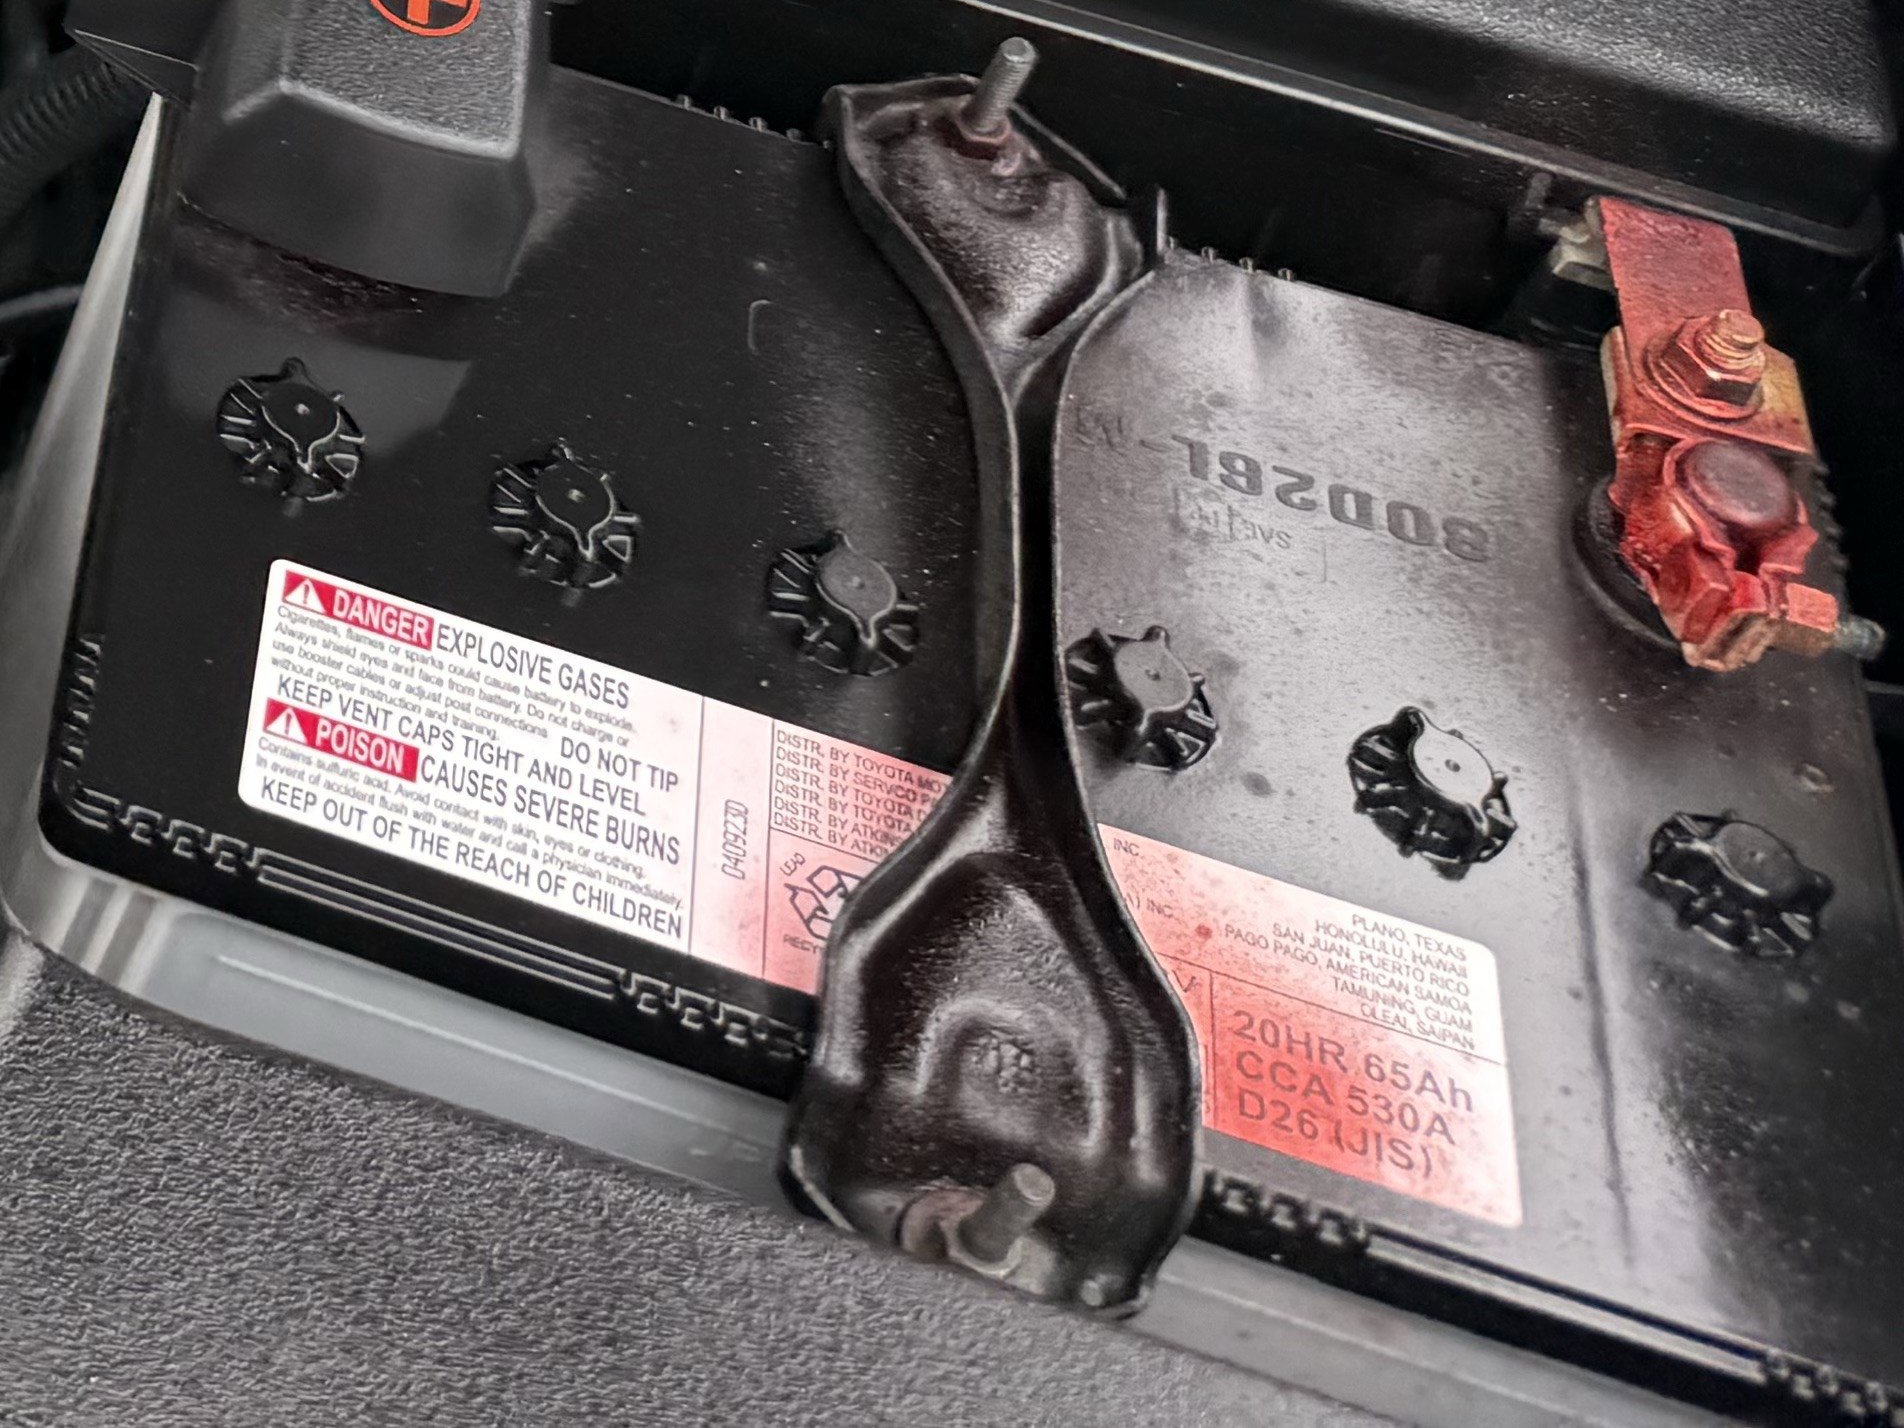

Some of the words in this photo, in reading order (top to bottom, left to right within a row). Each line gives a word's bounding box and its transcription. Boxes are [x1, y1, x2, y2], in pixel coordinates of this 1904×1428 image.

[270, 654, 314, 680] without
[315, 670, 355, 695] proper
[359, 683, 421, 715] instruction
[424, 704, 448, 724] and
[271, 640, 294, 656] use
[297, 646, 343, 672] booster
[345, 662, 386, 686] cables
[388, 678, 401, 691] or
[404, 682, 441, 706] adjust
[444, 695, 471, 716] post
[474, 704, 548, 740] connections
[273, 620, 318, 648] Always
[321, 636, 356, 658] shield
[359, 651, 388, 671] eyes
[391, 659, 415, 678] and
[417, 667, 444, 688] face
[447, 677, 475, 698] from
[526, 703, 544, 721] Do
[547, 711, 568, 729] not
[570, 717, 613, 745] charge
[616, 735, 629, 749] or
[331, 587, 429, 645] DANGER
[435, 622, 553, 686] EXPLOSIVE
[557, 660, 629, 711] GASES
[345, 627, 385, 651] flames
[388, 644, 400, 656] or
[404, 646, 444, 672] sparks
[447, 660, 480, 682] could
[483, 674, 520, 695] cause
[523, 685, 566, 713] battery
[569, 700, 581, 715] to
[277, 673, 332, 712] KEEP
[335, 692, 393, 732] VENT
[397, 712, 455, 753] CAPS
[459, 733, 524, 776] TIGHT
[527, 755, 572, 792] AND
[579, 772, 646, 816] LEVEL
[559, 735, 591, 766] DO
[596, 746, 641, 783] NOT
[646, 763, 678, 796] TIP
[829, 745, 849, 765] BY
[853, 753, 913, 786] TOYOTA
[829, 762, 849, 782] BY
[255, 752, 268, 769] In
[270, 759, 305, 781] event
[307, 770, 320, 786] of
[322, 775, 375, 805] accident
[377, 794, 409, 817] flush
[411, 805, 437, 826] with
[440, 817, 475, 839] water
[478, 828, 502, 848] and
[505, 836, 527, 856] call
[530, 848, 539, 860] a
[542, 849, 602, 884] physician
[257, 734, 314, 766] Contains
[315, 754, 360, 782] sulfuric
[394, 781, 430, 806] Avoid
[432, 794, 479, 822] contact
[482, 810, 508, 832] with
[543, 834, 574, 856] eyes
[576, 844, 589, 859] or
[314, 716, 405, 775] POISON
[419, 752, 508, 808] CAUSES
[512, 782, 600, 839] SEVERE
[605, 813, 680, 866] BURNS
[827, 812, 848, 832] BY
[828, 779, 848, 798] BY
[852, 787, 913, 820] TOYOTA
[828, 796, 848, 815] BY
[851, 803, 911, 836] TOYOTA
[260, 775, 317, 816] KEEP
[321, 795, 367, 833] OUT
[371, 812, 402, 845] OF
[405, 824, 450, 861] THE
[455, 840, 530, 888] REACH
[536, 867, 567, 900] OF
[571, 878, 682, 940] CHILDREN
[827, 828, 847, 848] BY
[1223, 922, 1270, 952] PAGO
[1325, 955, 1410, 996] AMERICAN
[1412, 983, 1472, 1016] SAMOA
[1271, 921, 1305, 946] SAN
[1358, 949, 1424, 984] PUERTO
[1429, 971, 1470, 998] RICO
[1410, 949, 1468, 980] HAWAII
[1414, 933, 1466, 963] TEXAS
[1415, 1018, 1475, 1052] SAIPAN
[1423, 1004, 1473, 1033] GUAM
[1231, 1006, 1348, 1074] 20HR
[1362, 1048, 1473, 1114] 65Ah
[1235, 1045, 1334, 1107] CCA
[1344, 1081, 1455, 1146] 530A
[1237, 1085, 1319, 1143] D26
[1333, 1116, 1433, 1181] (JIS)
